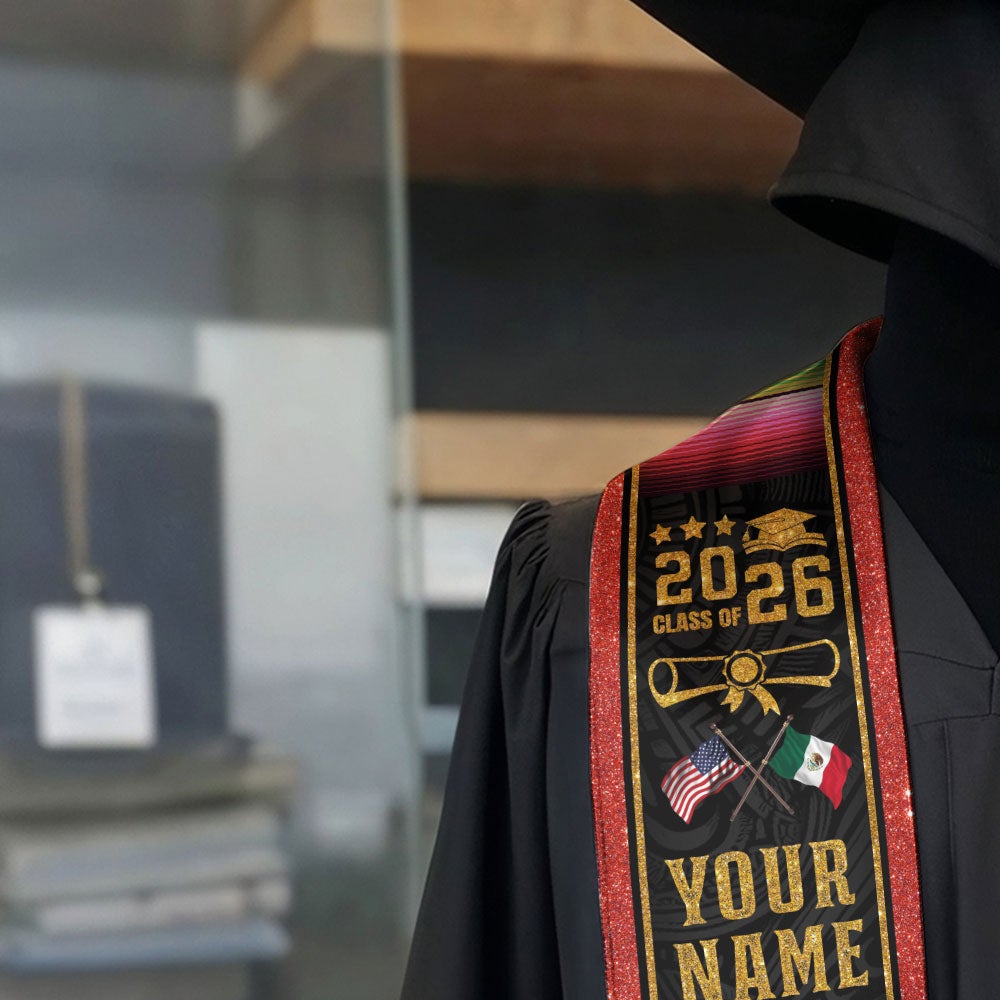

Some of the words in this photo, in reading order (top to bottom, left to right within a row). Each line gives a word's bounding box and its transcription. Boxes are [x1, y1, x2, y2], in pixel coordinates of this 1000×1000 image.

[652, 611, 713, 635] CLASS
[718, 606, 742, 627] OF
[655, 545, 835, 625] 2026
[664, 838, 856, 927] YOUR
